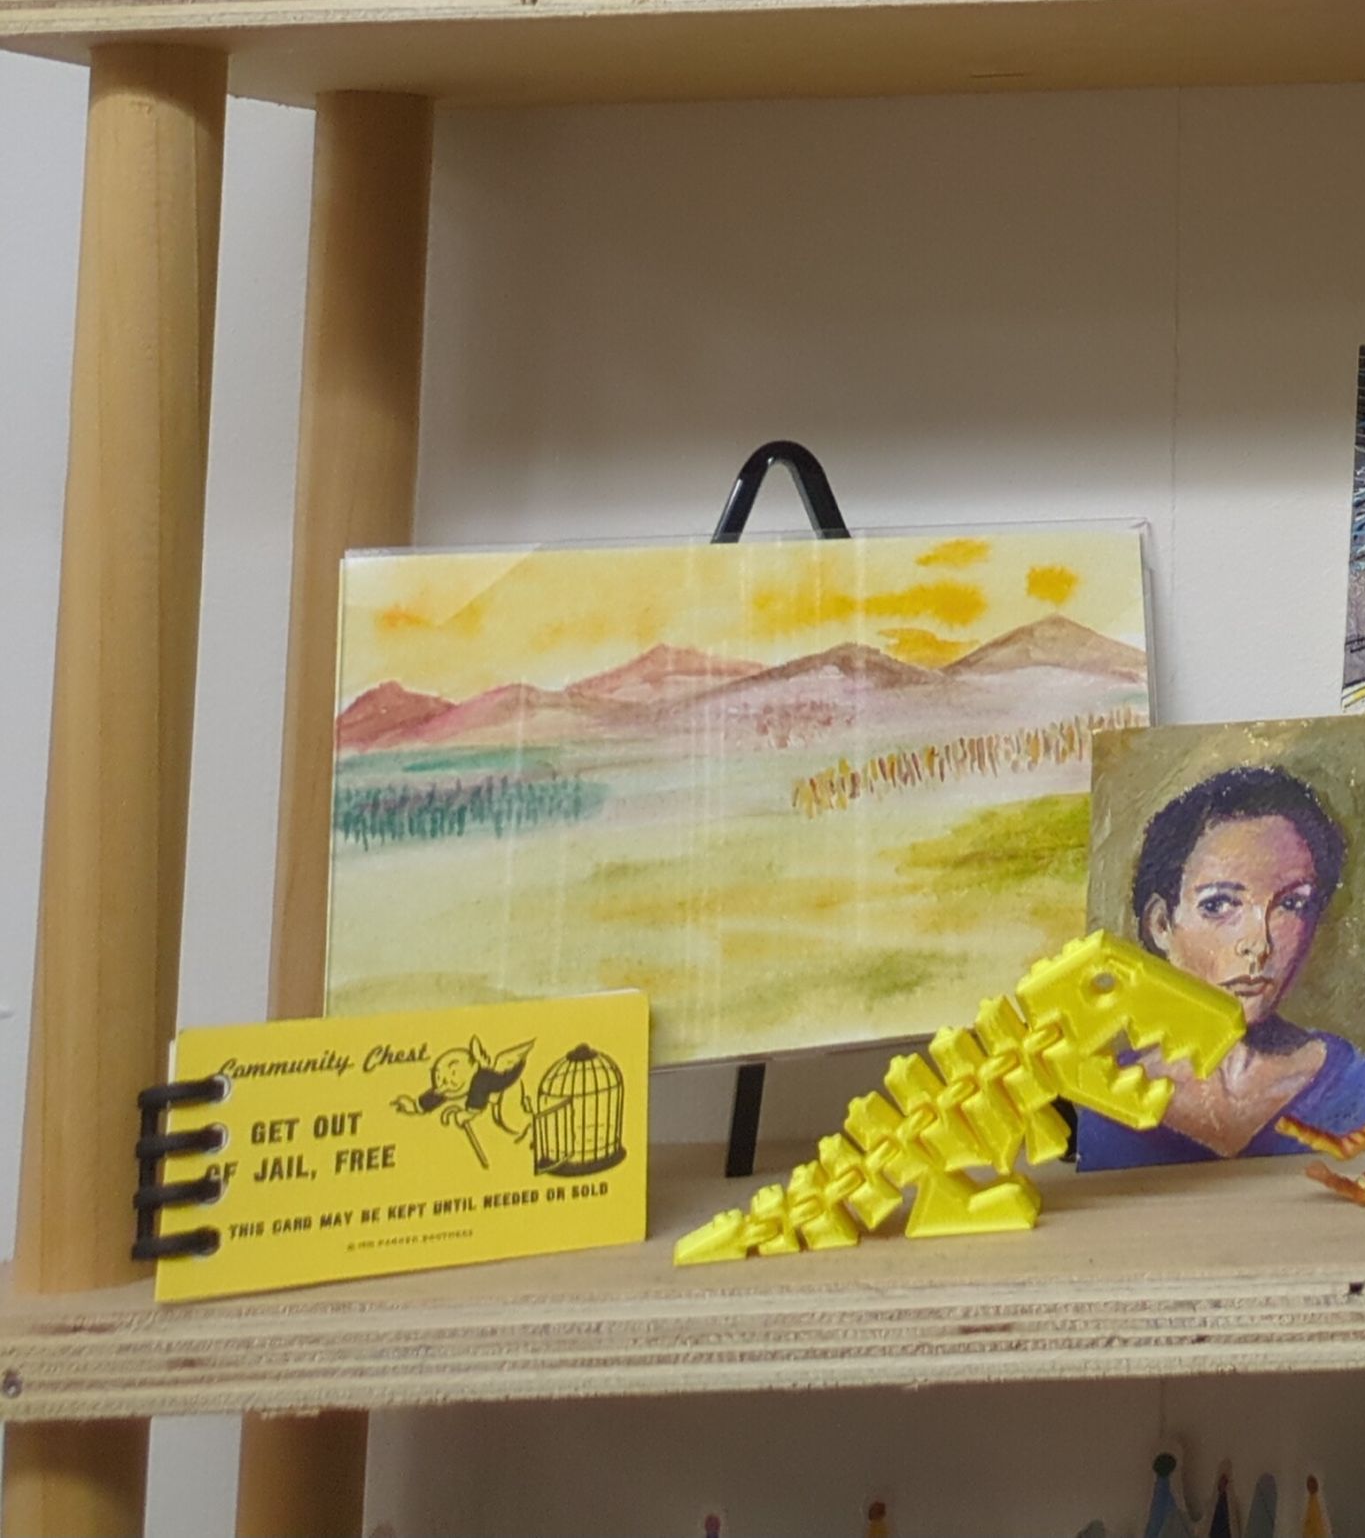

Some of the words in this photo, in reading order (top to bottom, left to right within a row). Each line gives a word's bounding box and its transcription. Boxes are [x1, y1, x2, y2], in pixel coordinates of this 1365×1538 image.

[218, 1050, 355, 1079] Community
[362, 1042, 431, 1073] Chest
[251, 1117, 300, 1146] GET
[313, 1111, 363, 1140] OUT
[253, 1154, 318, 1183] JAIL,
[335, 1143, 397, 1174] FREE
[228, 1220, 265, 1240] THIS
[272, 1215, 312, 1235] CARD
[319, 1210, 354, 1230] MAY
[360, 1207, 381, 1224] BE
[387, 1202, 427, 1220] KEPT
[433, 1196, 477, 1215] UNTIL
[483, 1189, 539, 1209] NEEDED
[546, 1186, 566, 1202] OR
[571, 1181, 609, 1199] SOLD
